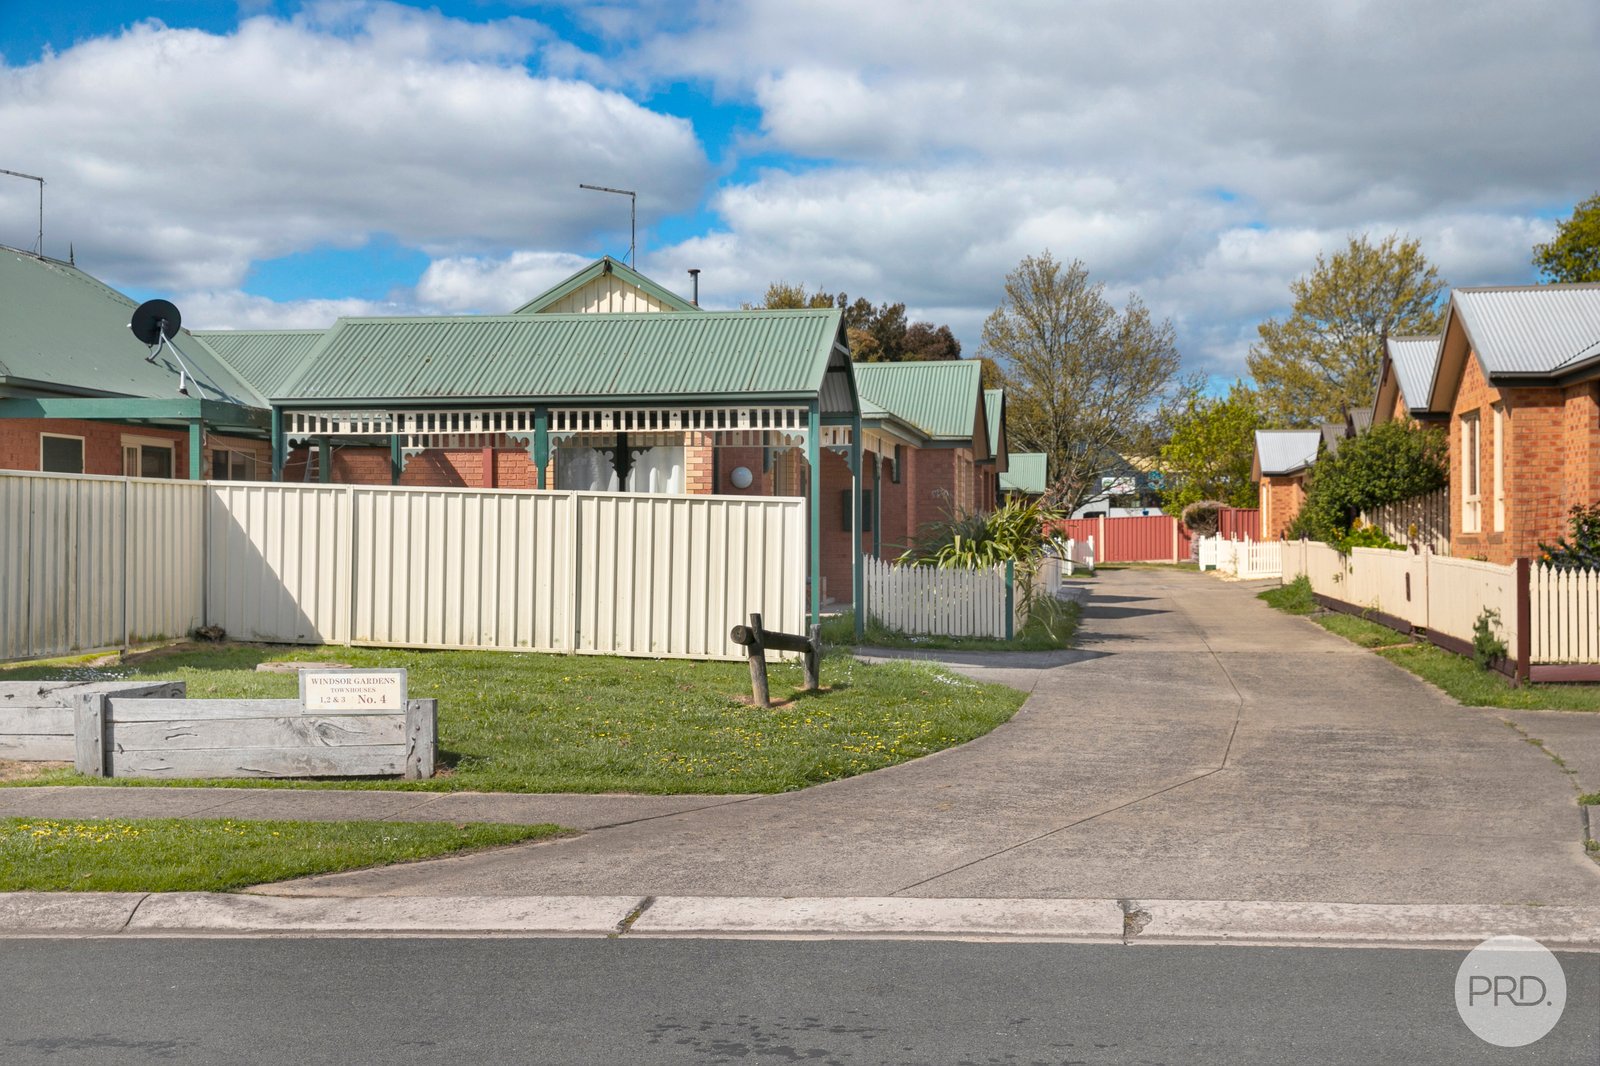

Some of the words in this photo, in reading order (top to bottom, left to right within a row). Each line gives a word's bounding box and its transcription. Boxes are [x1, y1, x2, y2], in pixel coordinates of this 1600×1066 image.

[311, 677, 352, 685] WINDSOR
[353, 677, 396, 685] GARDENS
[332, 696, 339, 704] &
[341, 696, 346, 704] 3
[357, 694, 377, 704] No.
[379, 694, 387, 704] 4
